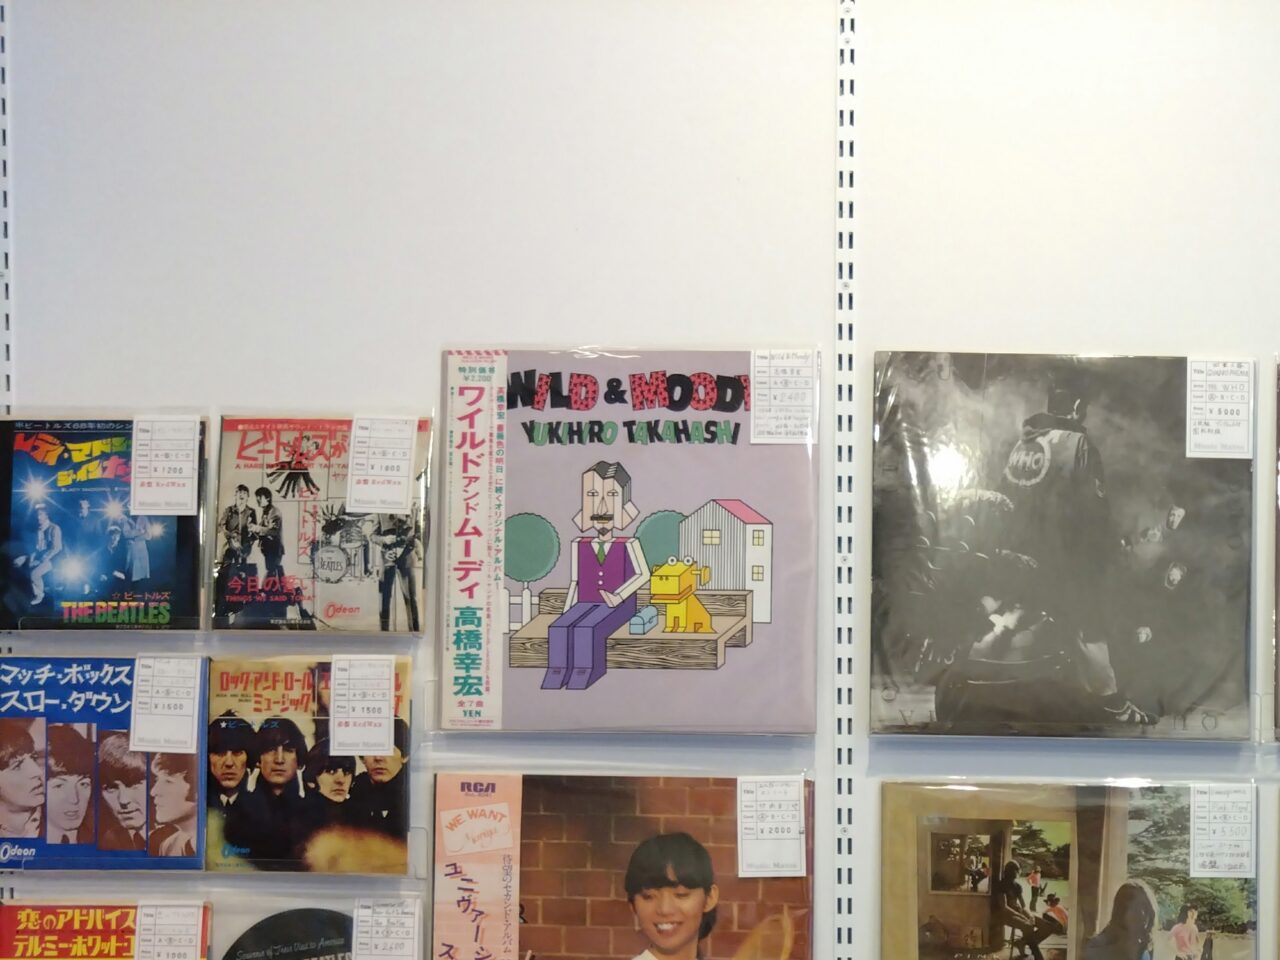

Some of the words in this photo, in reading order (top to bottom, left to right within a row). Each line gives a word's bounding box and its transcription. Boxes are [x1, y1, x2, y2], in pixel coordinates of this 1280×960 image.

[506, 369, 600, 412] WILD
[604, 377, 628, 405] &
[521, 419, 619, 447] YUKIHIRO
[622, 418, 741, 447] TAKAHASHI
[1009, 451, 1045, 471] WHO
[61, 602, 94, 624] THE
[95, 602, 170, 624] BEATLES
[324, 601, 361, 619] Odeon
[452, 606, 484, 697] 高橋幸宏
[0, 663, 133, 686] マッチ・ボックス
[0, 690, 132, 713] スロー・ダウン
[460, 781, 496, 794] RCA
[445, 814, 466, 832] WE
[466, 808, 508, 824] WANT
[0, 842, 36, 860] Odeon
[17, 908, 137, 930] 恋のアドバイス
